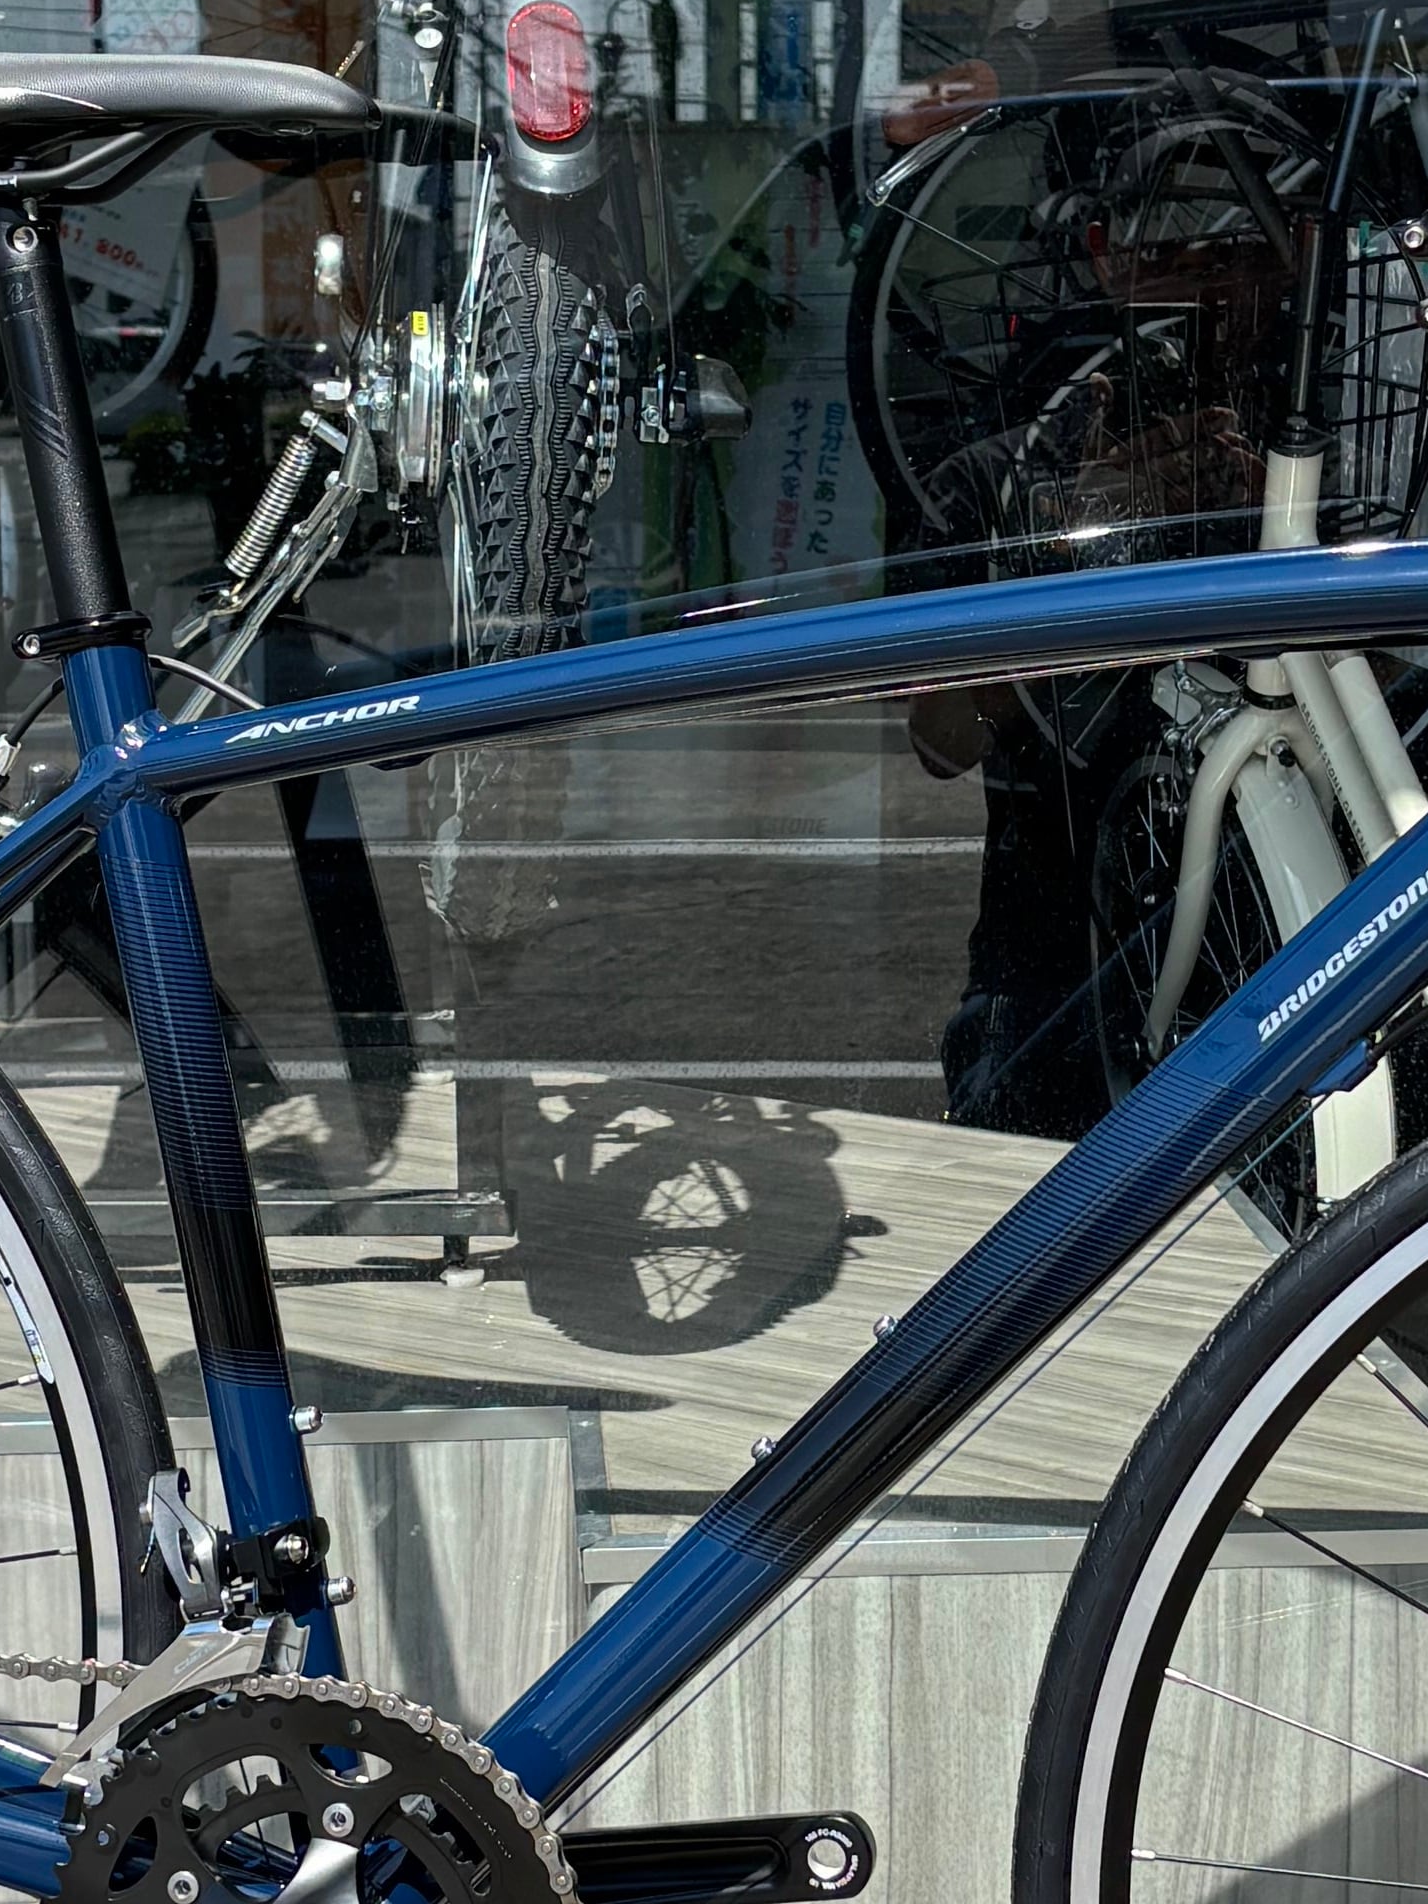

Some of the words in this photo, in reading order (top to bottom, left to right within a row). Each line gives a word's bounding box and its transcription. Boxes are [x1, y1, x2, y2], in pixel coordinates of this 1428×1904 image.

[805, 400, 849, 555] 自分にあった
[224, 695, 421, 745] ANCHOR
